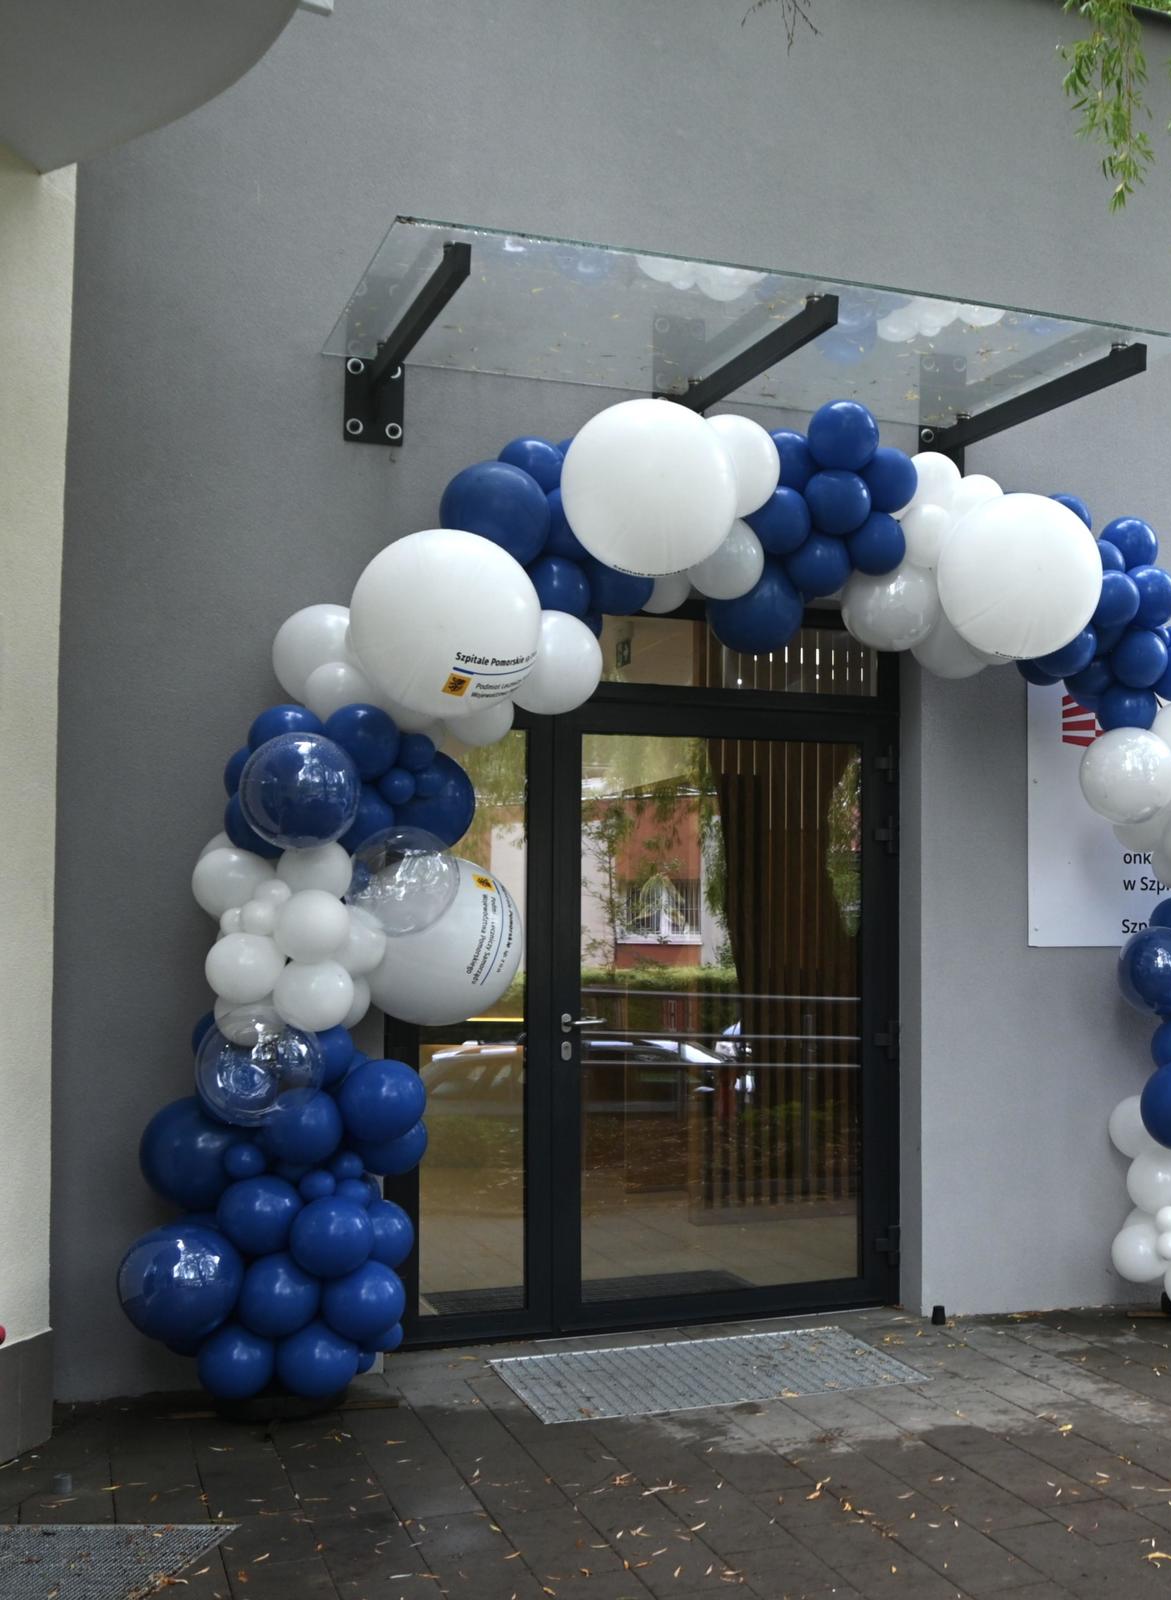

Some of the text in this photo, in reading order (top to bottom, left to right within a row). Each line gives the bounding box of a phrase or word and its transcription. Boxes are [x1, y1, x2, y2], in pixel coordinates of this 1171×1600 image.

[455, 651, 489, 666] Szpitale
[490, 656, 524, 667] Pomorskie
[1123, 880, 1136, 891] w
